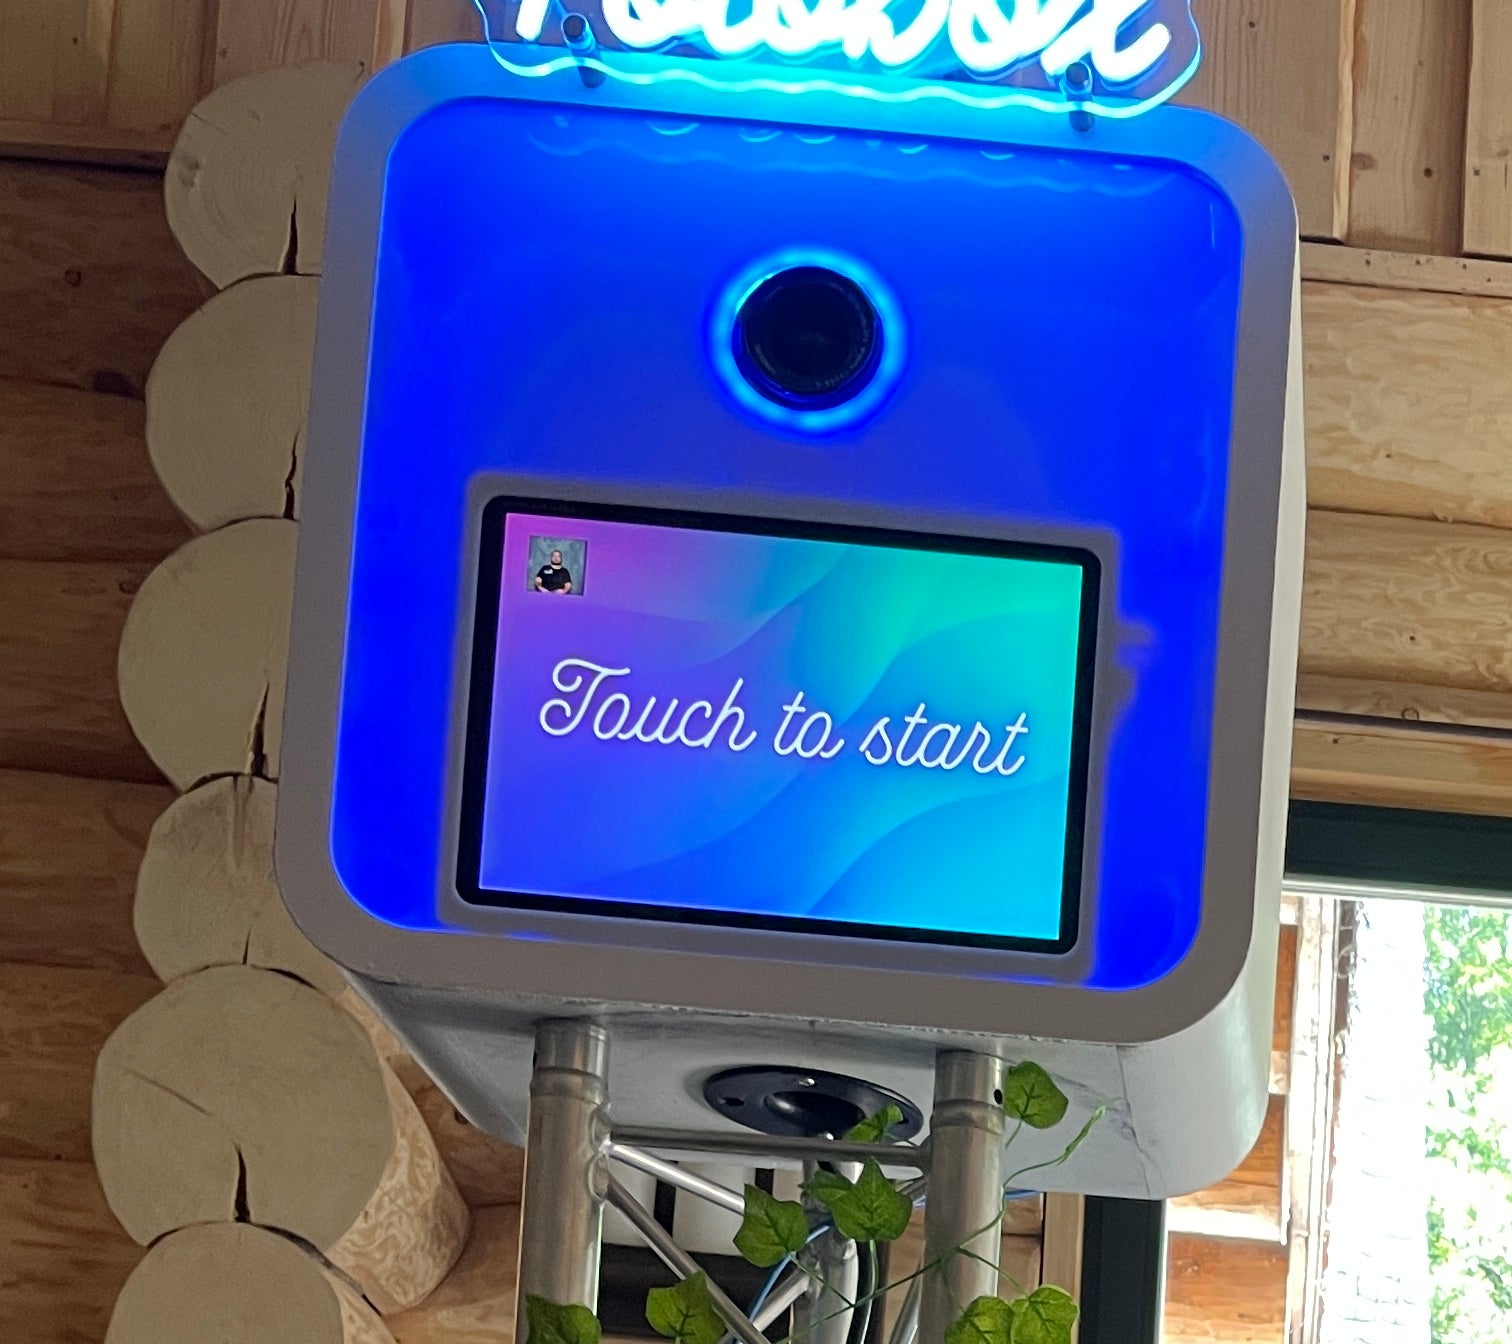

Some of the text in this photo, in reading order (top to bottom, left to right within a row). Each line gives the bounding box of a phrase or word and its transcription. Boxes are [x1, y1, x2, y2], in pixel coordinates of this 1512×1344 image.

[539, 658, 1030, 776] Touch to start
